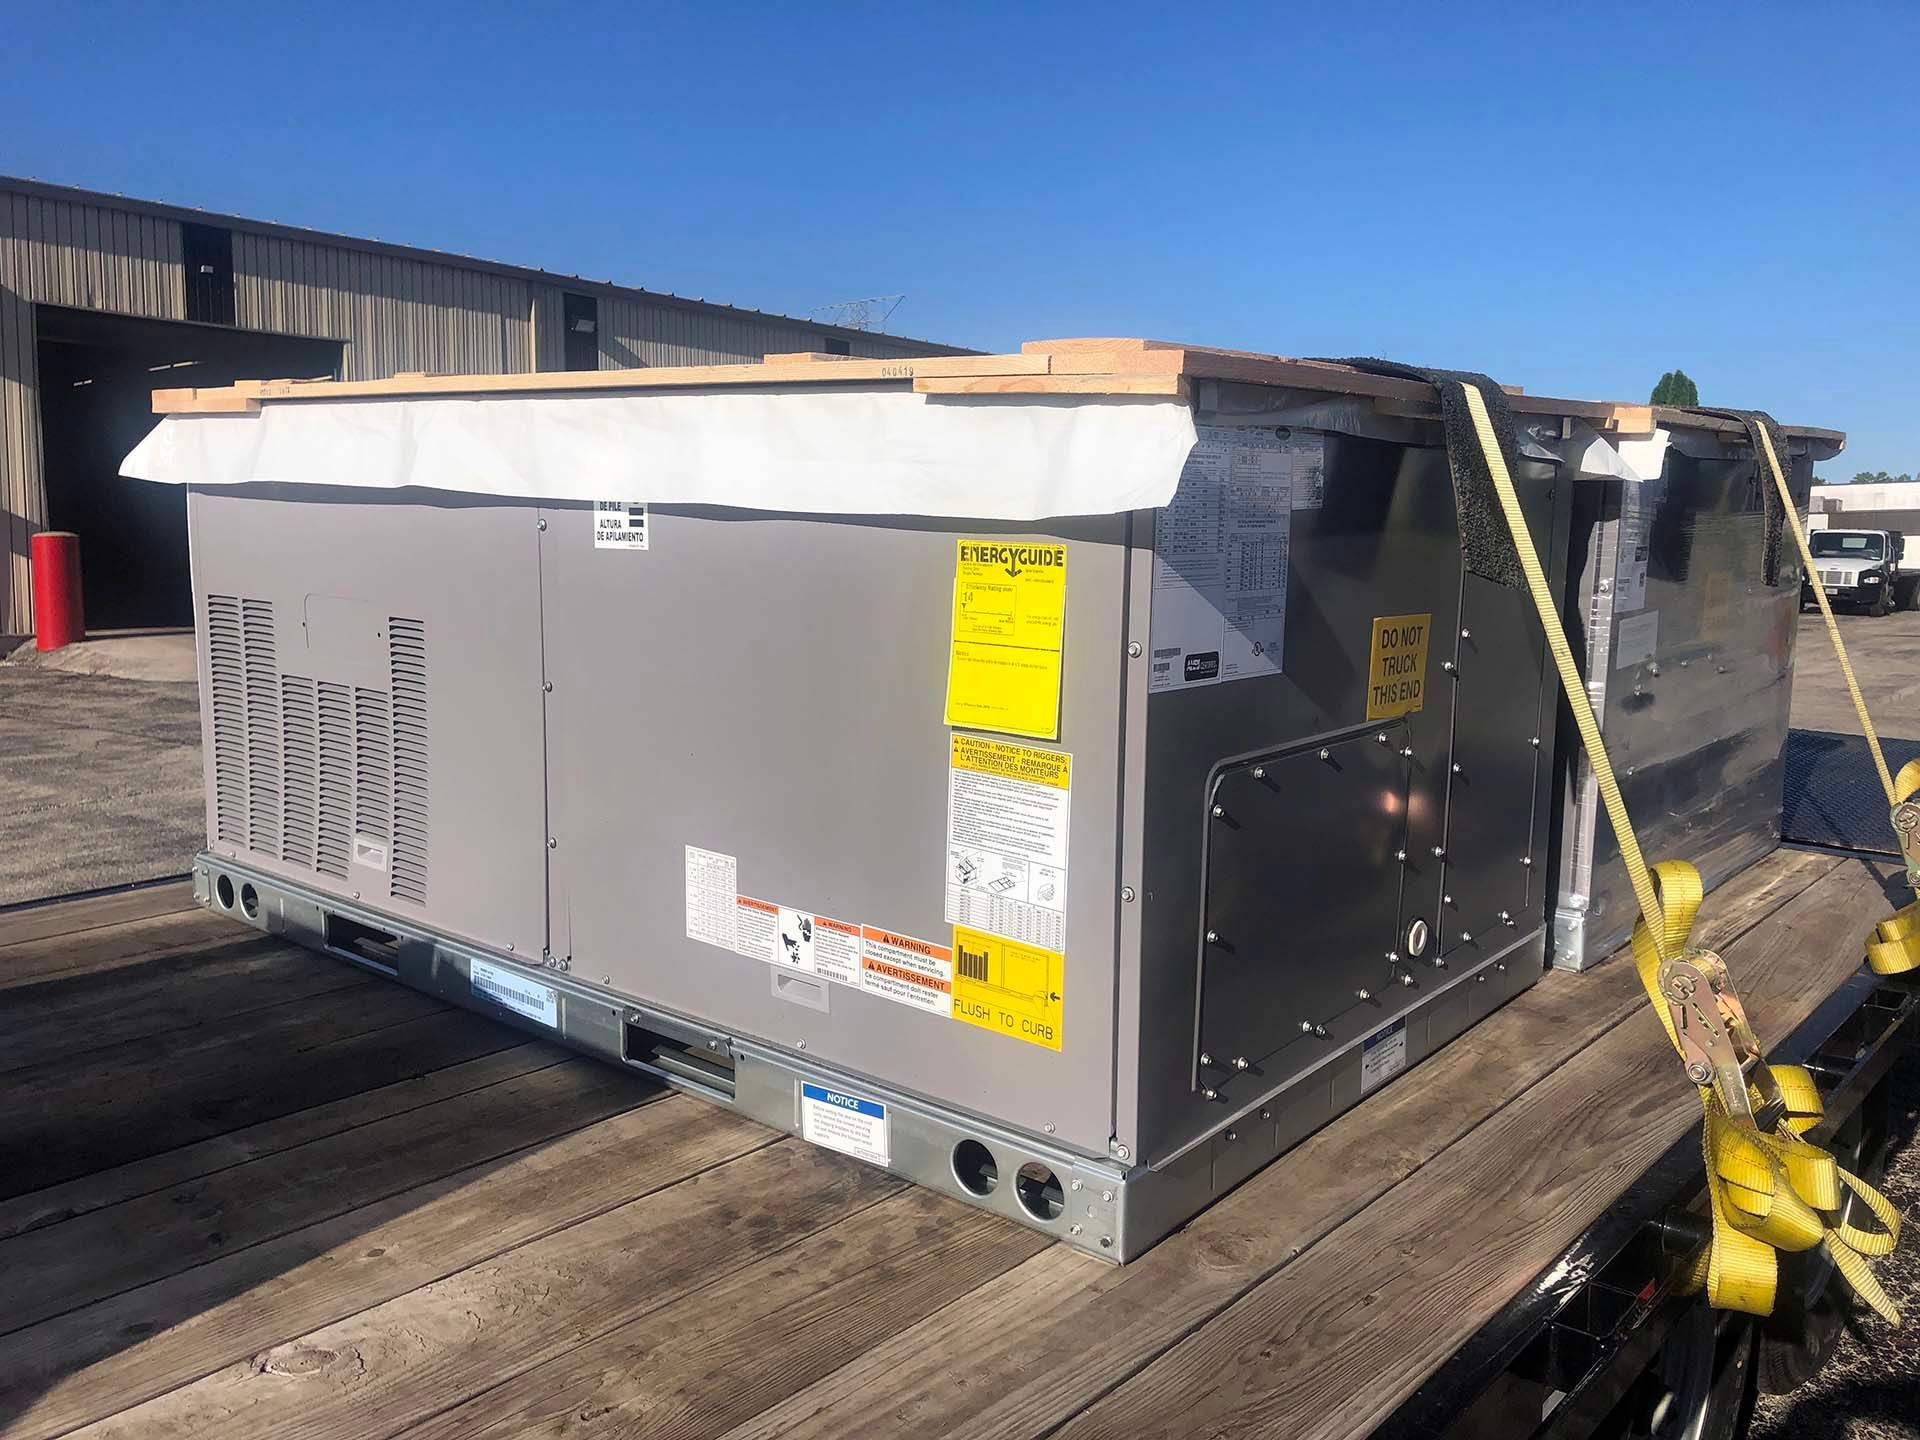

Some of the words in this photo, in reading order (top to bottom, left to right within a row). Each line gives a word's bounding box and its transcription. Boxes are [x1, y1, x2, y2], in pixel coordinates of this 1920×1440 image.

[600, 501, 608, 511] DE
[609, 501, 621, 511] PILE
[600, 519, 622, 529] ALTURA
[597, 531, 604, 541] DE
[606, 531, 644, 542] APILAMIENTO
[960, 545, 1064, 568] ENERGYGUIDE
[1382, 628, 1398, 648] DO
[1400, 626, 1424, 647] NOT
[1382, 653, 1418, 677] TRUCK
[1373, 684, 1398, 706] THIS
[1400, 680, 1420, 700] END
[960, 738, 990, 750] CAUTION
[996, 744, 1020, 756] NOTICE
[1022, 750, 1032, 758] TO
[1034, 752, 1066, 764] RIGGERS
[960, 747, 1016, 762] AVERTISSEMENT
[1022, 758, 1060, 772] REMARQUE
[960, 754, 1003, 768] L'ATTENTION
[1004, 762, 1018, 771] DES
[1020, 765, 1059, 779] MONTEURS
[866, 940, 876, 949] This
[878, 945, 912, 960] compartment
[914, 956, 928, 964] must
[892, 936, 930, 954] WARNING
[865, 949, 882, 958] closed
[884, 954, 901, 964] except
[902, 960, 917, 968] when
[876, 964, 944, 990] AVERTISSEMENT
[922, 990, 938, 999] rester
[954, 998, 990, 1021] FLUSH
[999, 1011, 1014, 1028] TO
[1022, 1019, 1053, 1040] CURB
[827, 1092, 859, 1110] NOTICE
